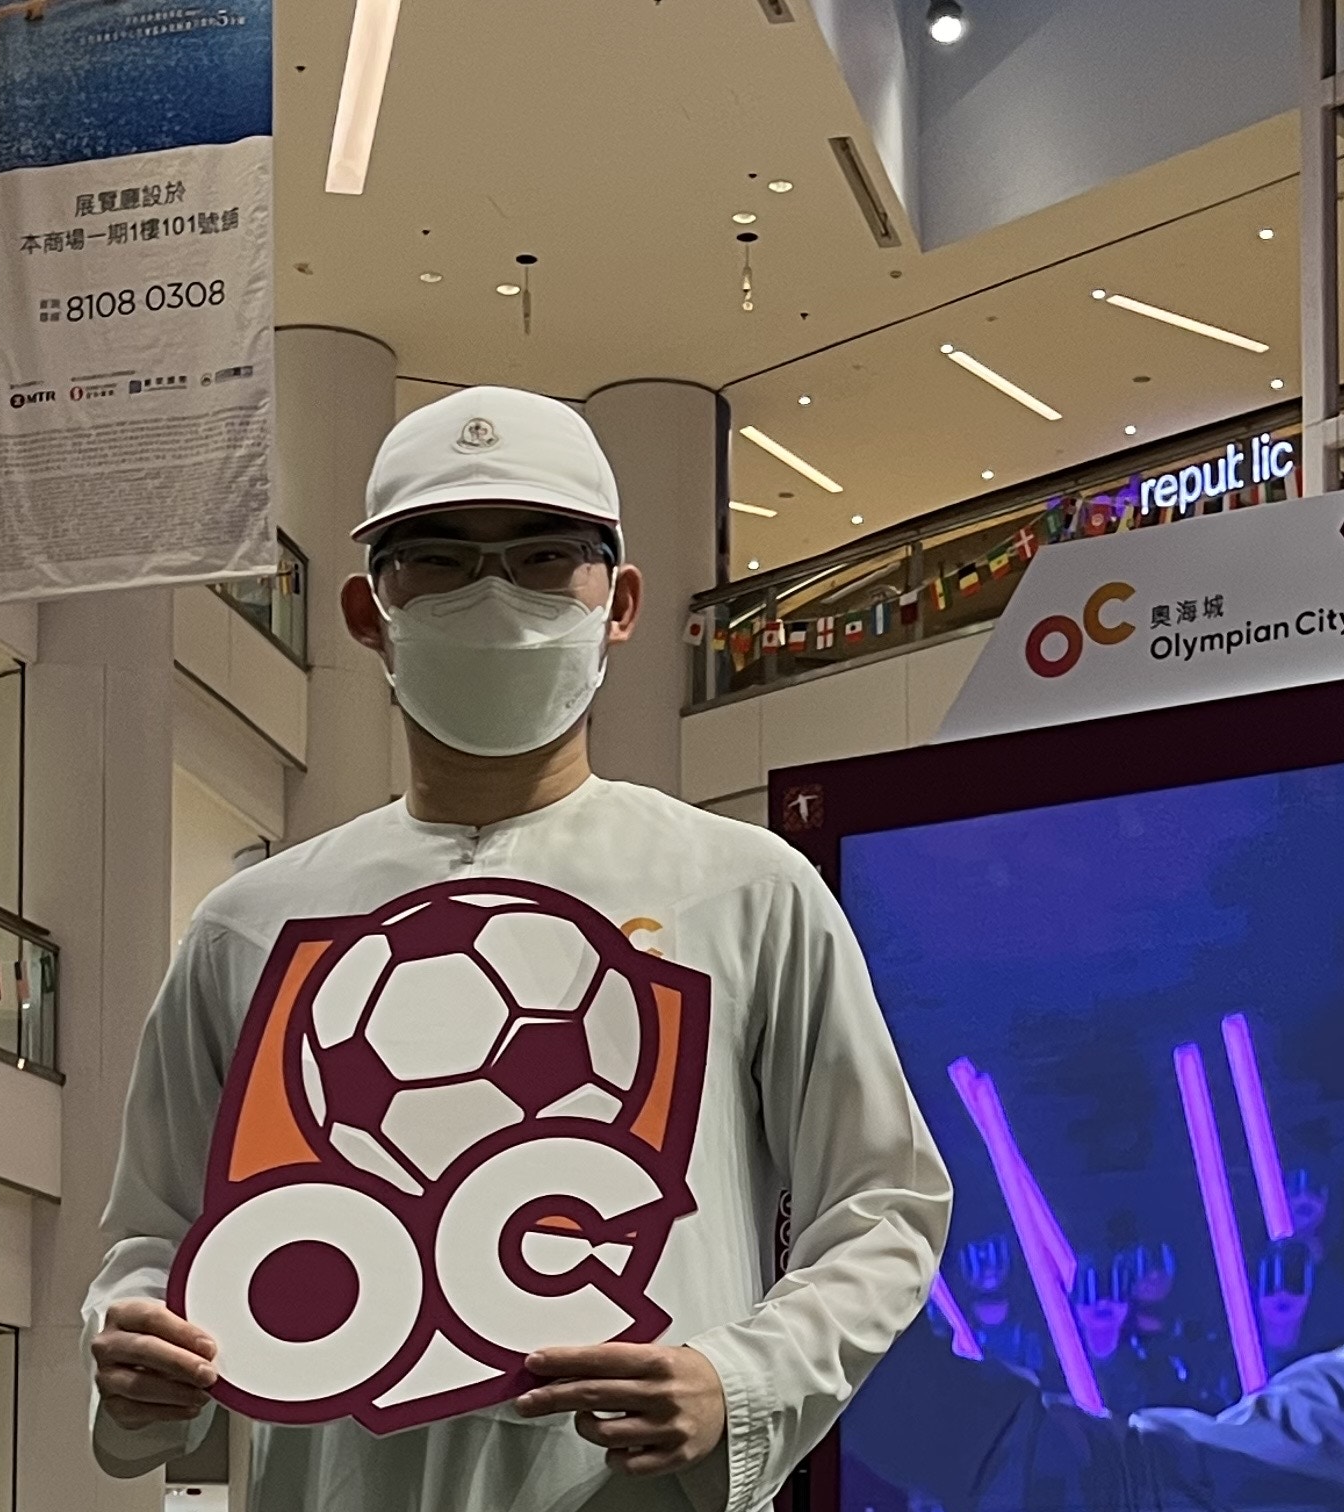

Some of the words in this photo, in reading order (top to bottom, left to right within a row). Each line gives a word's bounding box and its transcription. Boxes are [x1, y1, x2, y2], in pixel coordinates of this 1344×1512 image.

[66, 289, 137, 323] 8108
[145, 279, 226, 311] 0308
[1025, 581, 1136, 679] OC
[1150, 620, 1290, 661] Olympian
